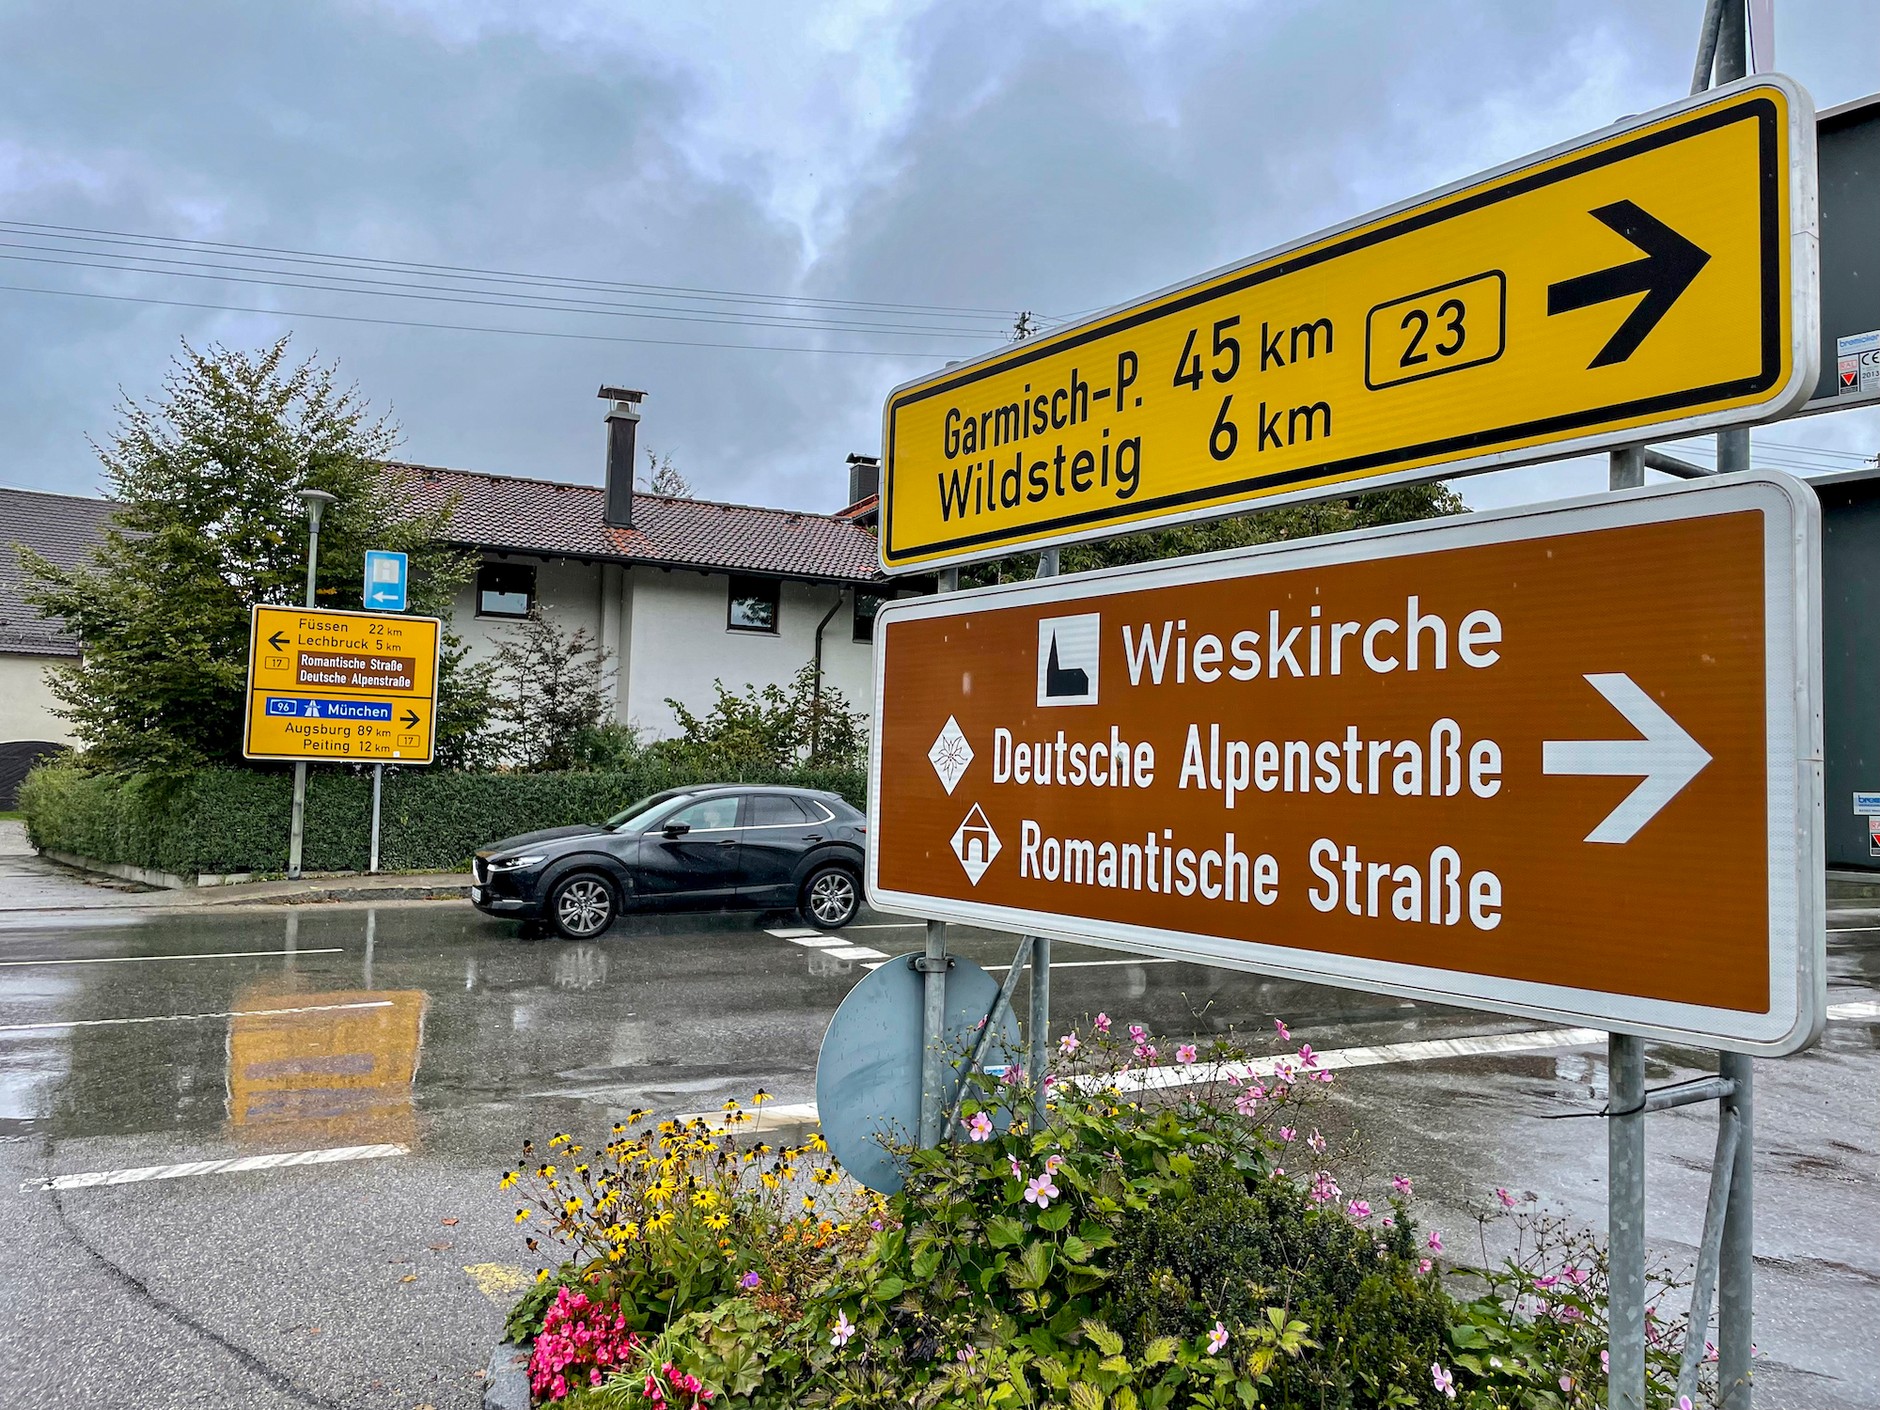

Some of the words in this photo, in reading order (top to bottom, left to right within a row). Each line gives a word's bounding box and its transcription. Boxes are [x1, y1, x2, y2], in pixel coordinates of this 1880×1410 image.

[1399, 299, 1468, 369] 23
[1862, 371, 1880, 379] 2013
[943, 348, 1142, 461] Garmisch-P.
[1172, 314, 1242, 392] 45
[1260, 317, 1335, 373] km
[938, 431, 1142, 523] Wildsteig
[1209, 395, 1239, 461] 6
[1258, 399, 1332, 453] km
[299, 618, 349, 632] Füssen
[369, 623, 384, 635] 22
[387, 627, 402, 637] km
[298, 634, 369, 650] Lechbruck
[376, 640, 383, 650] 5
[386, 642, 402, 651] km
[1122, 595, 1503, 688] Wieskirche
[272, 659, 282, 668] 17
[301, 654, 366, 670] Romantische
[370, 658, 403, 672] Straße
[299, 670, 347, 684] Deutsche
[351, 673, 411, 688] Alpenstraße
[277, 702, 290, 711] 96
[328, 703, 388, 718] München
[285, 722, 351, 737] Augsburg
[357, 725, 373, 737] 89
[376, 728, 391, 737] km
[303, 738, 350, 753] Peiting
[360, 741, 371, 752] 12
[375, 744, 390, 753] km
[404, 737, 414, 745] 17
[992, 725, 1156, 790] Deutsche
[1178, 716, 1504, 810] Alpenstraße
[1020, 819, 1279, 908] Romantische
[1307, 837, 1504, 932] Straße
